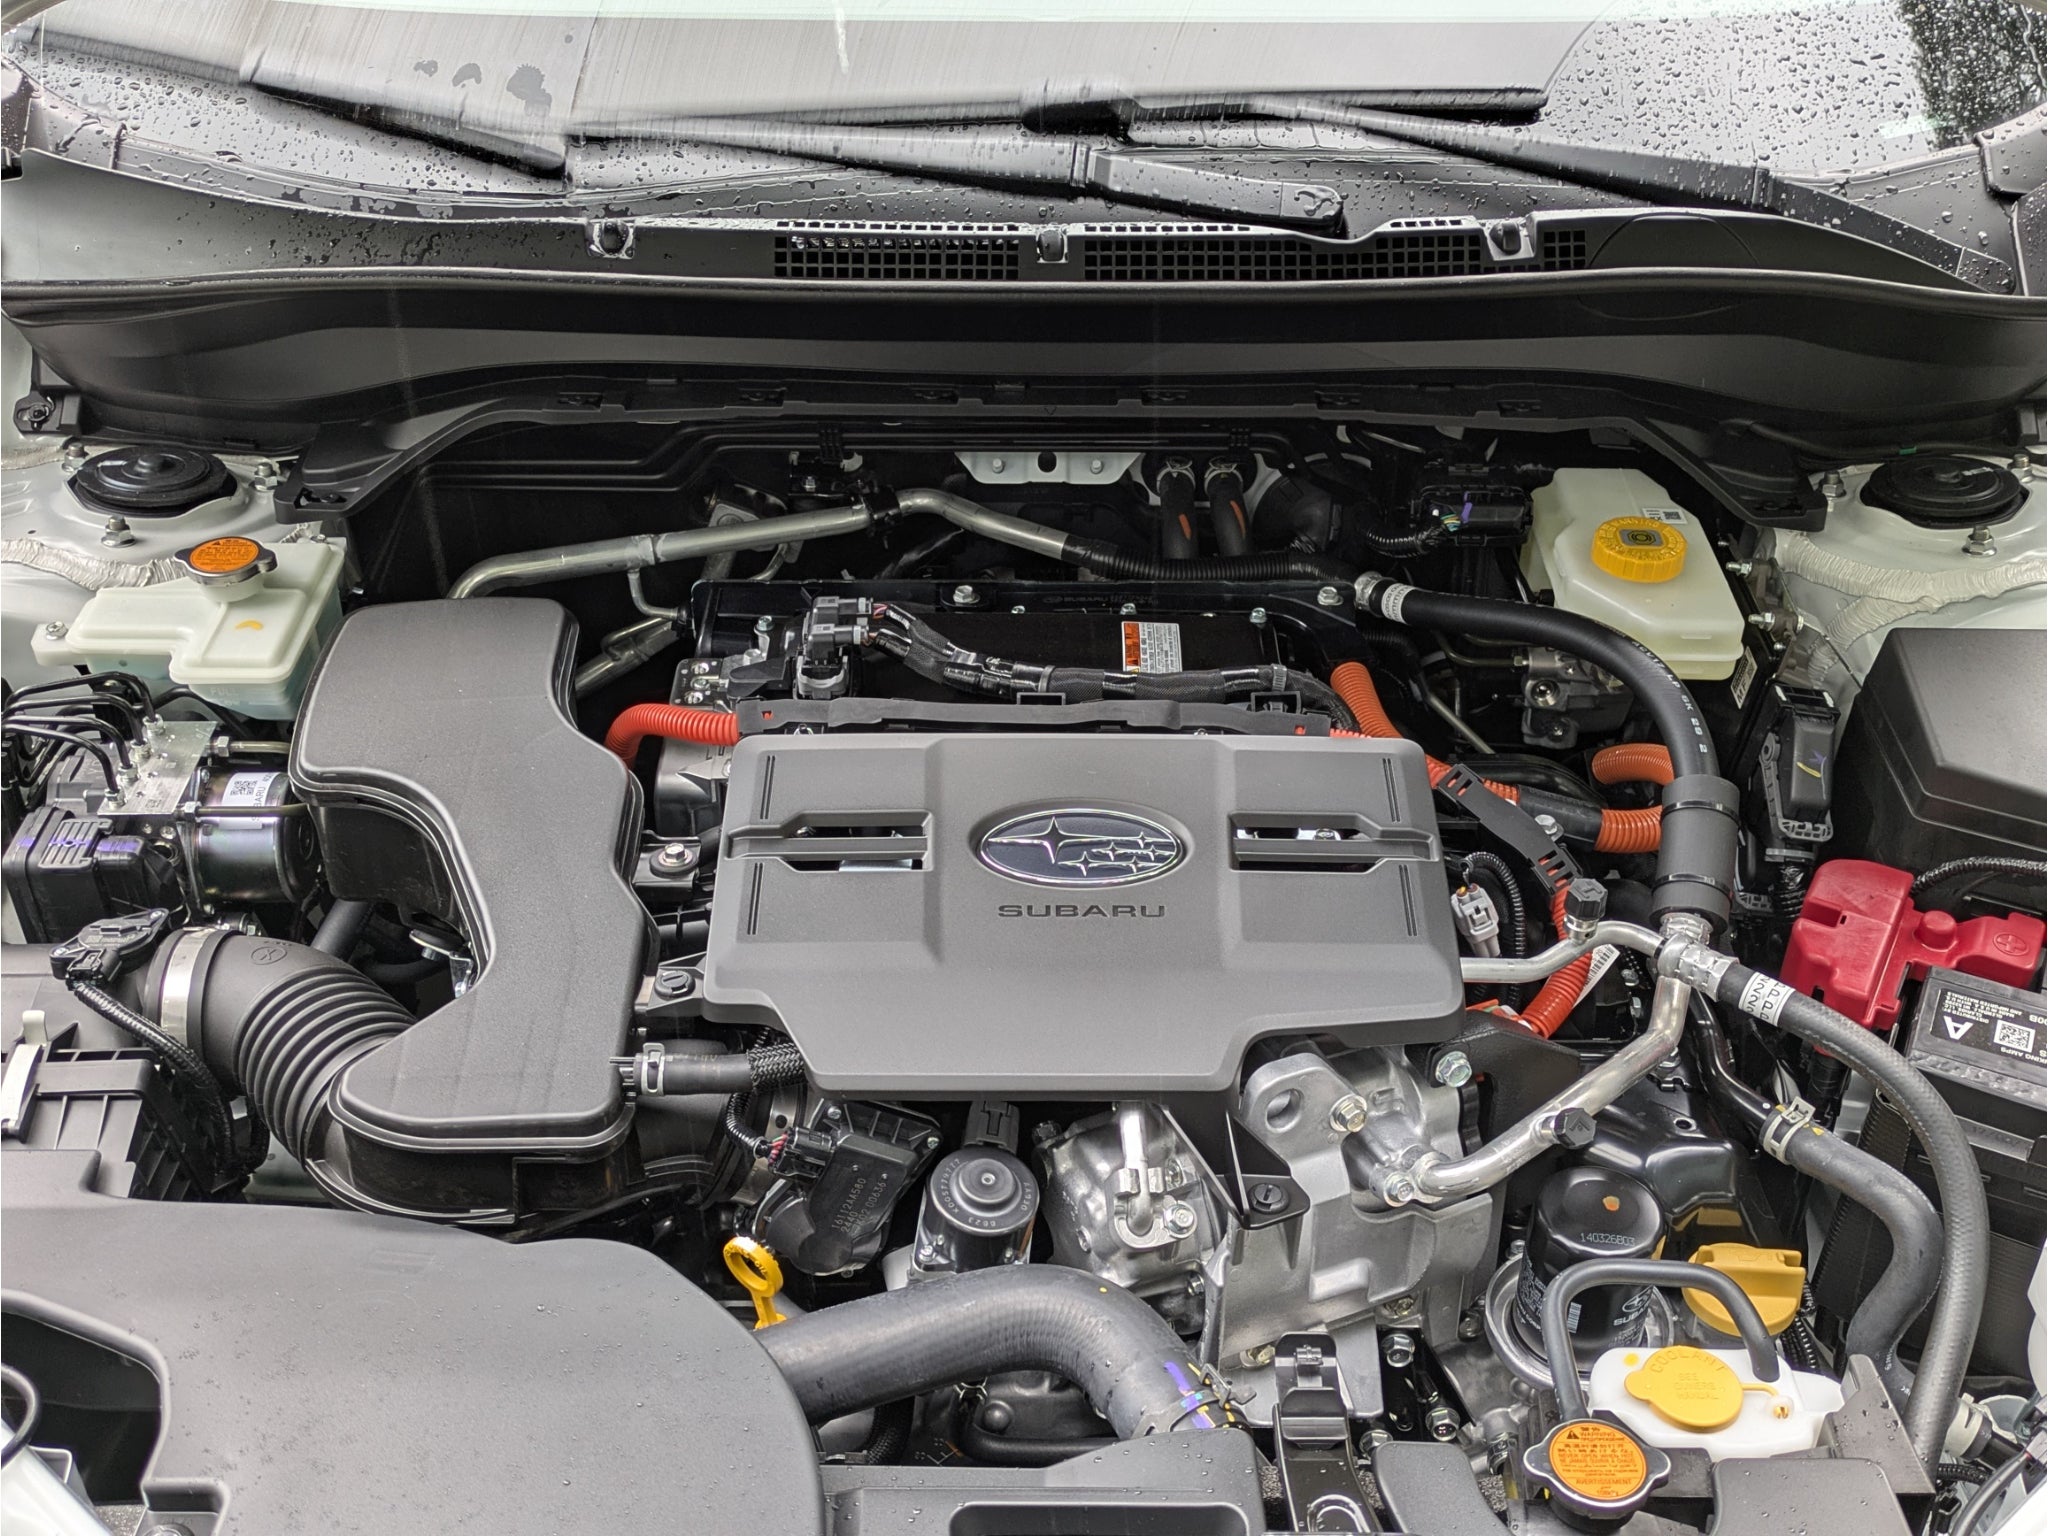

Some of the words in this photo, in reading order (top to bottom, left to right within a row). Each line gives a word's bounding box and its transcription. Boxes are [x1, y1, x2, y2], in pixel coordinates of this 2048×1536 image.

[998, 904, 1165, 918] SUBARU
[1943, 1015, 1974, 1040] A
[2001, 1047, 2024, 1057] AMPS
[1649, 1350, 1727, 1373] COOLANT
